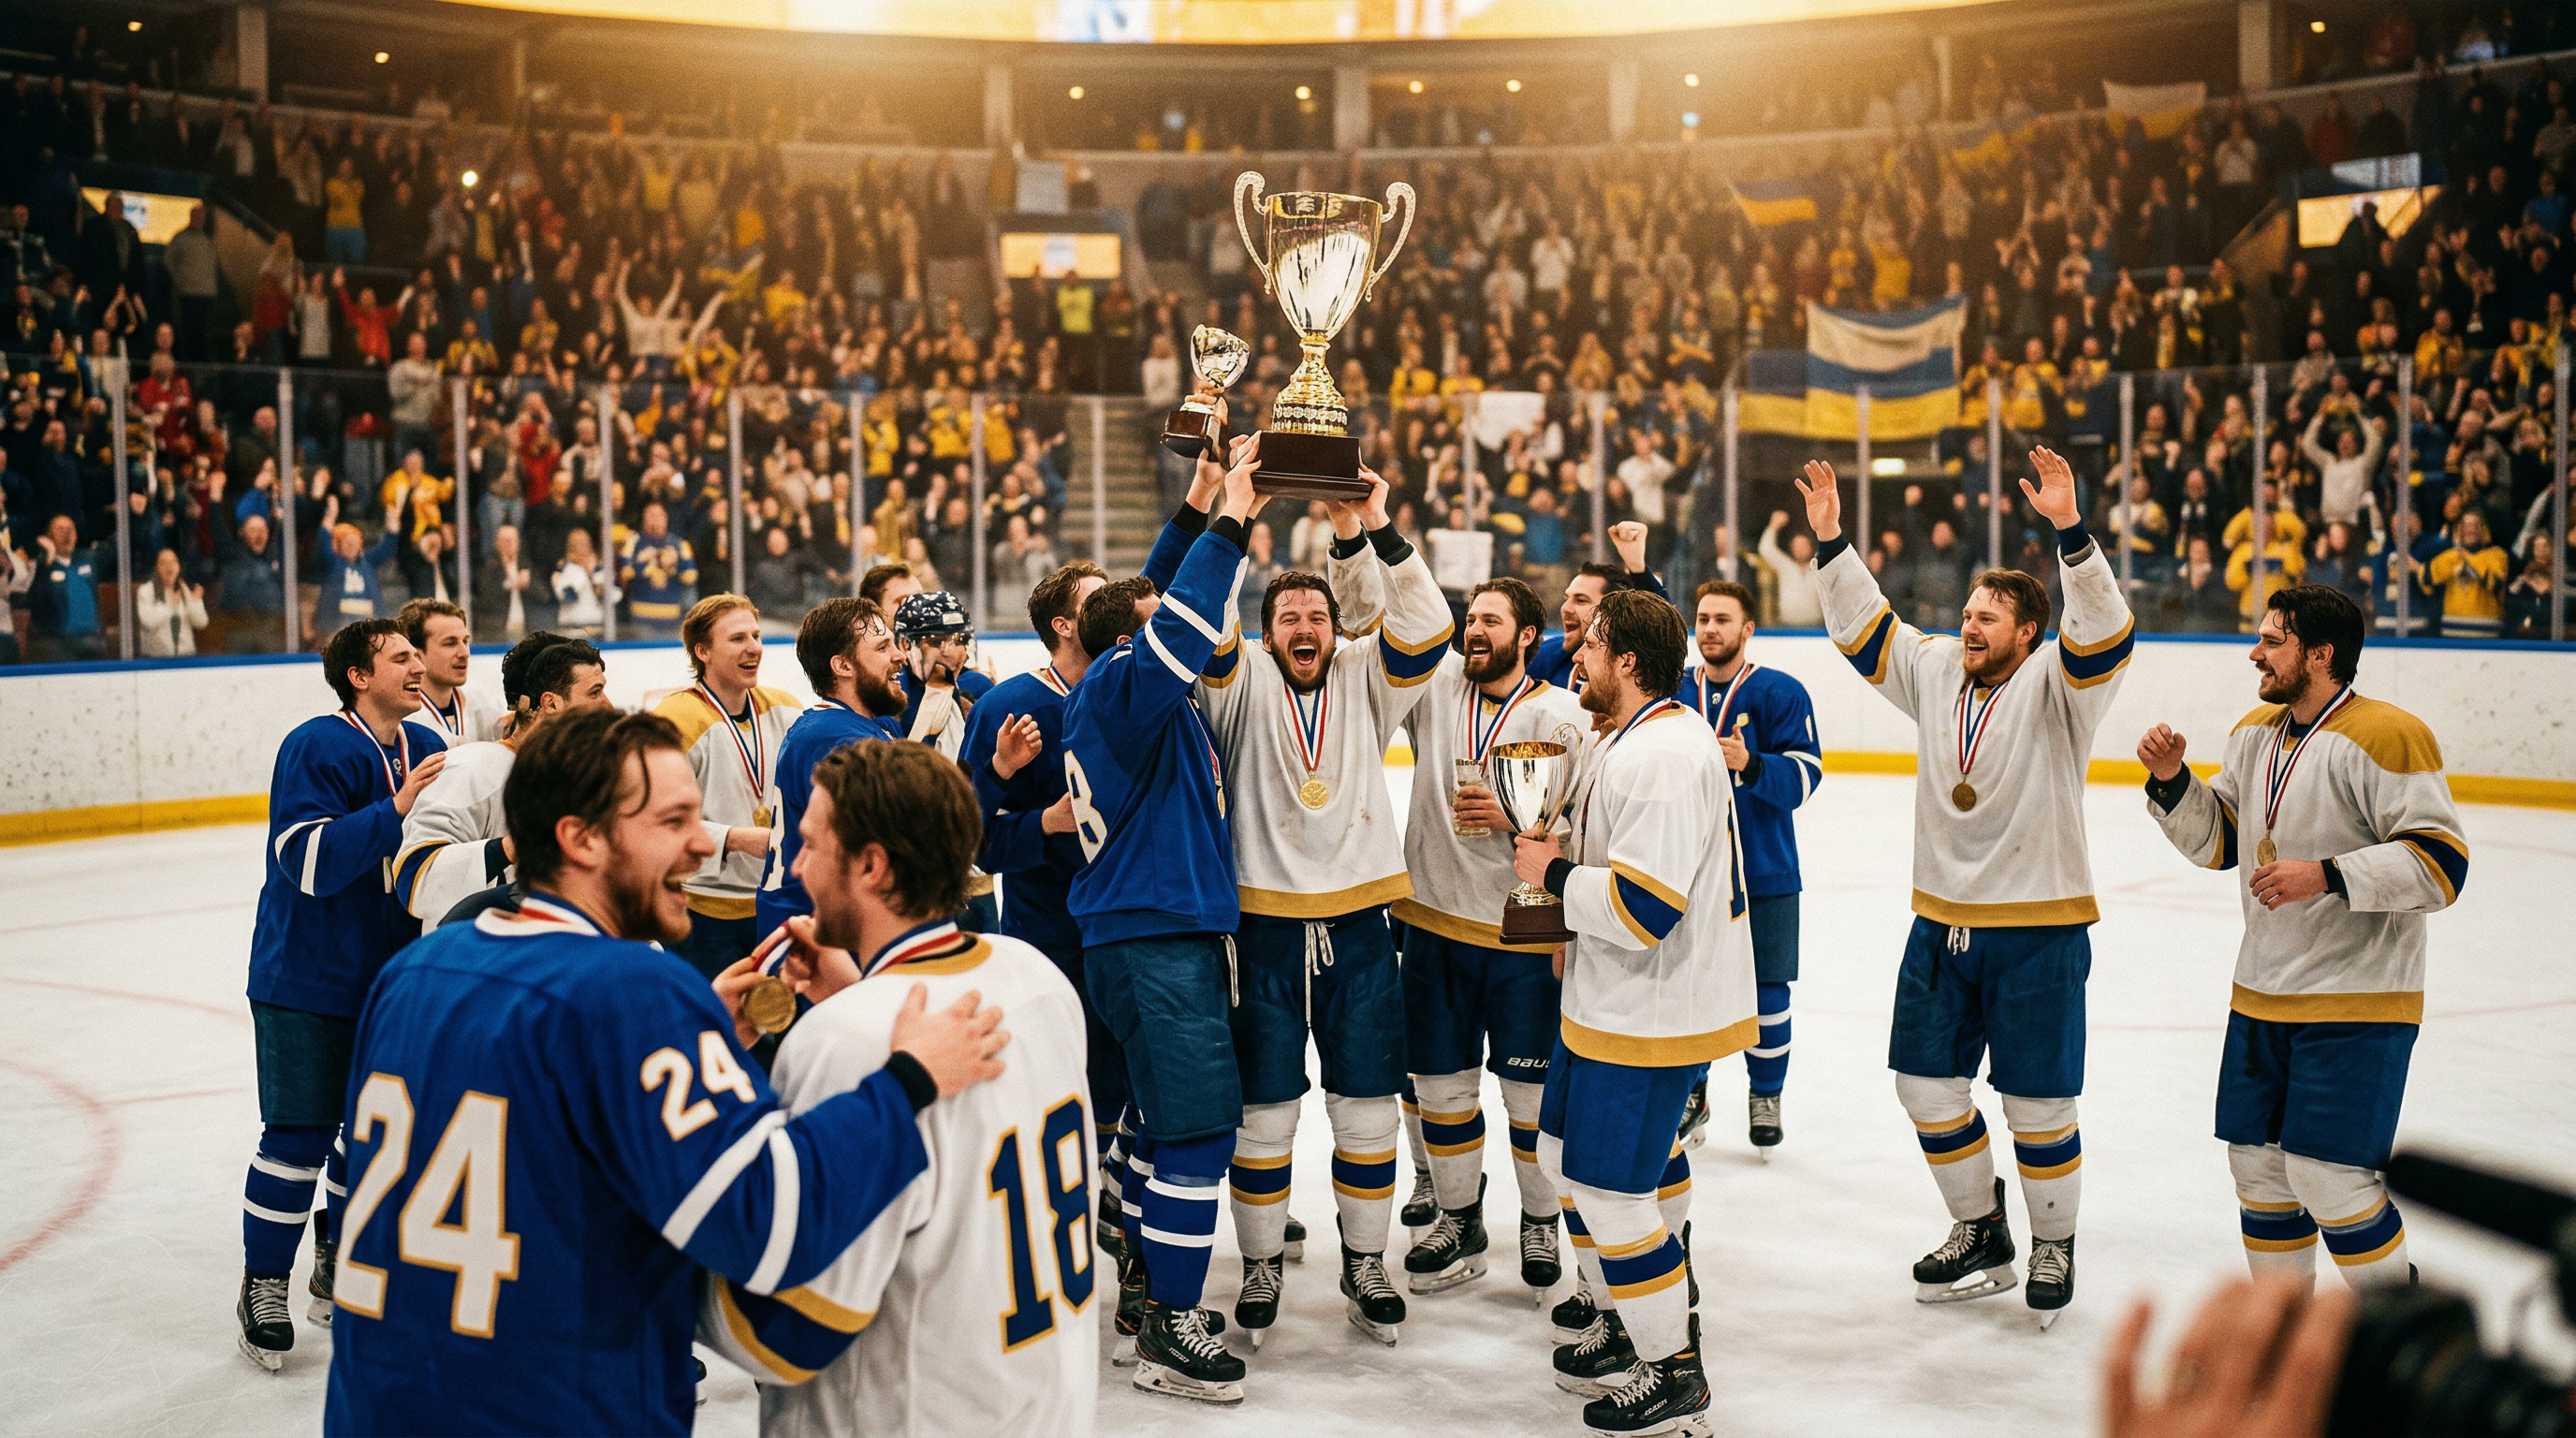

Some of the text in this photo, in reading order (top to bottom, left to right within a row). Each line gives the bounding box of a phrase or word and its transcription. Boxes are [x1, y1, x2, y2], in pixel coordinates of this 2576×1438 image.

[333, 1071, 520, 1340] 24
[638, 1029, 757, 1142] 24
[986, 1092, 1095, 1355] 18
